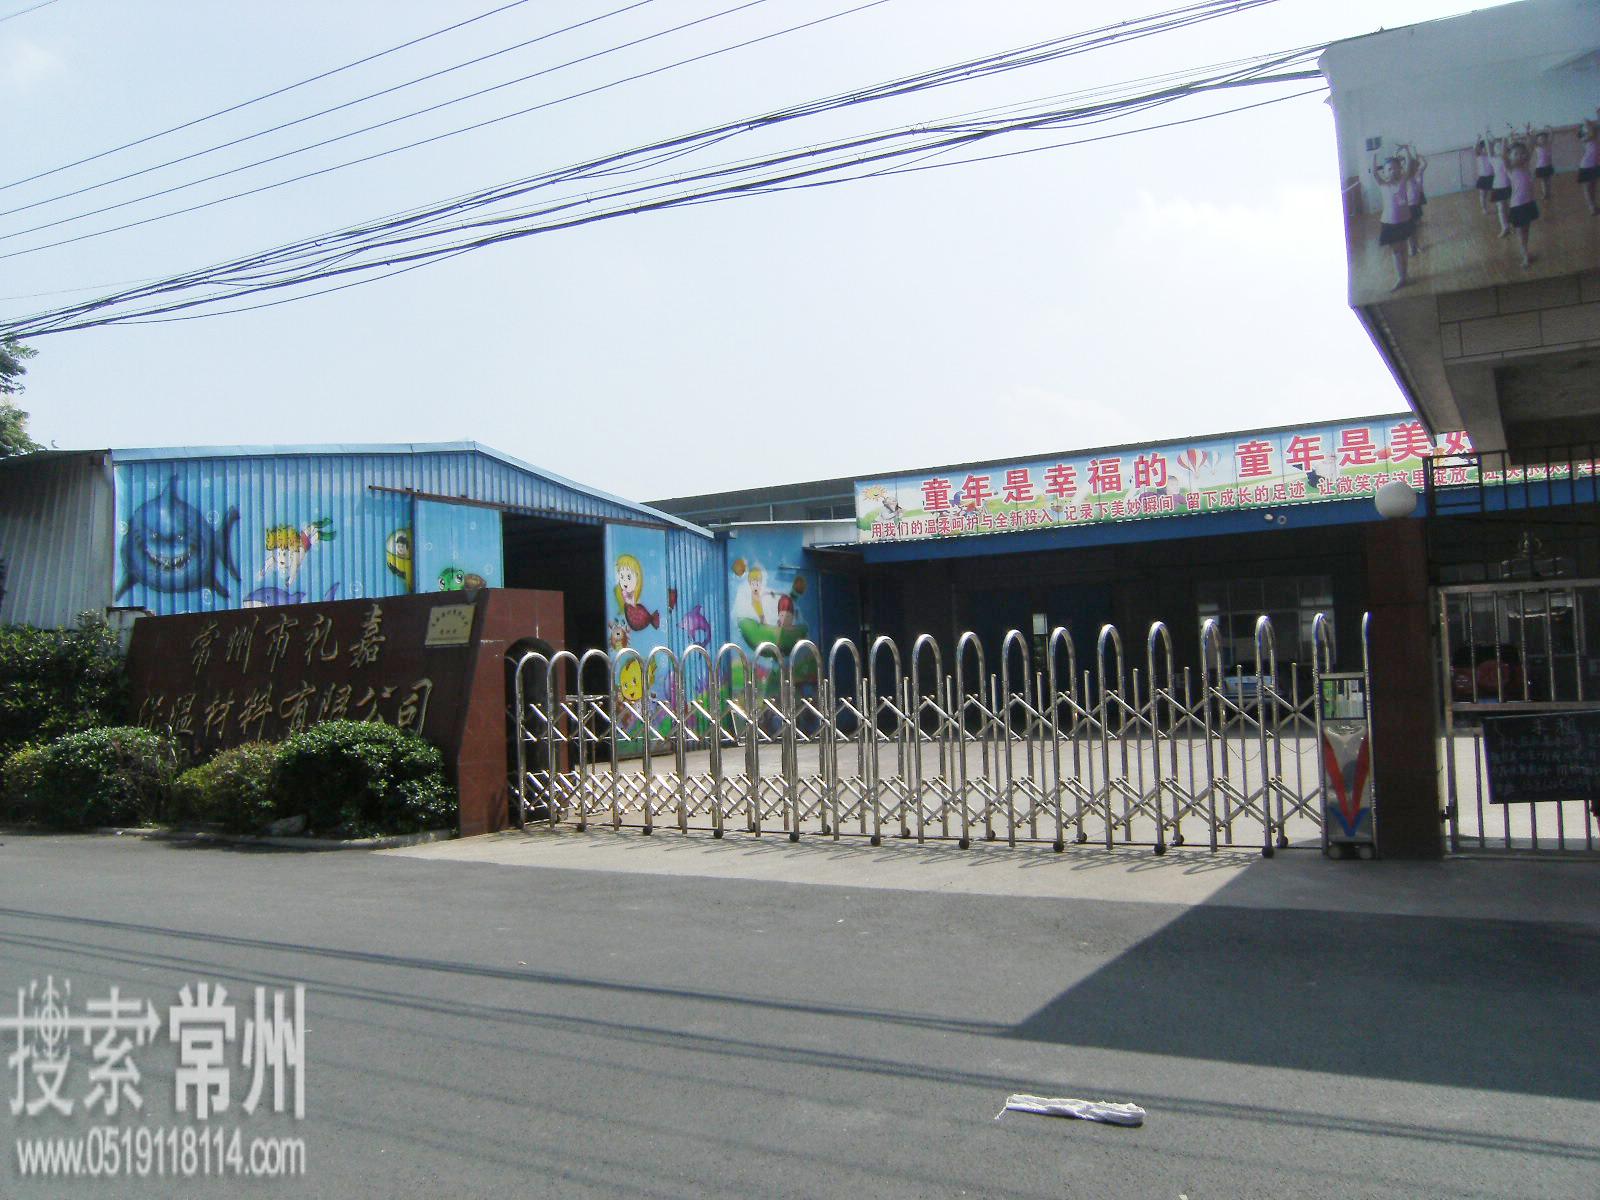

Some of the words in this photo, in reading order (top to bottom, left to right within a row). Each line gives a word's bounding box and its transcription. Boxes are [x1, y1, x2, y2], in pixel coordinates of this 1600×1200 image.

[871, 508, 1053, 538] 用我们的温柔呵护与全新投入
[1065, 495, 1174, 521] 记录下美妙瞬间
[1186, 482, 1306, 509] 留下成长的足迹
[921, 453, 1169, 512] 童年是幸福的
[192, 604, 386, 674] 常州市礼嘉
